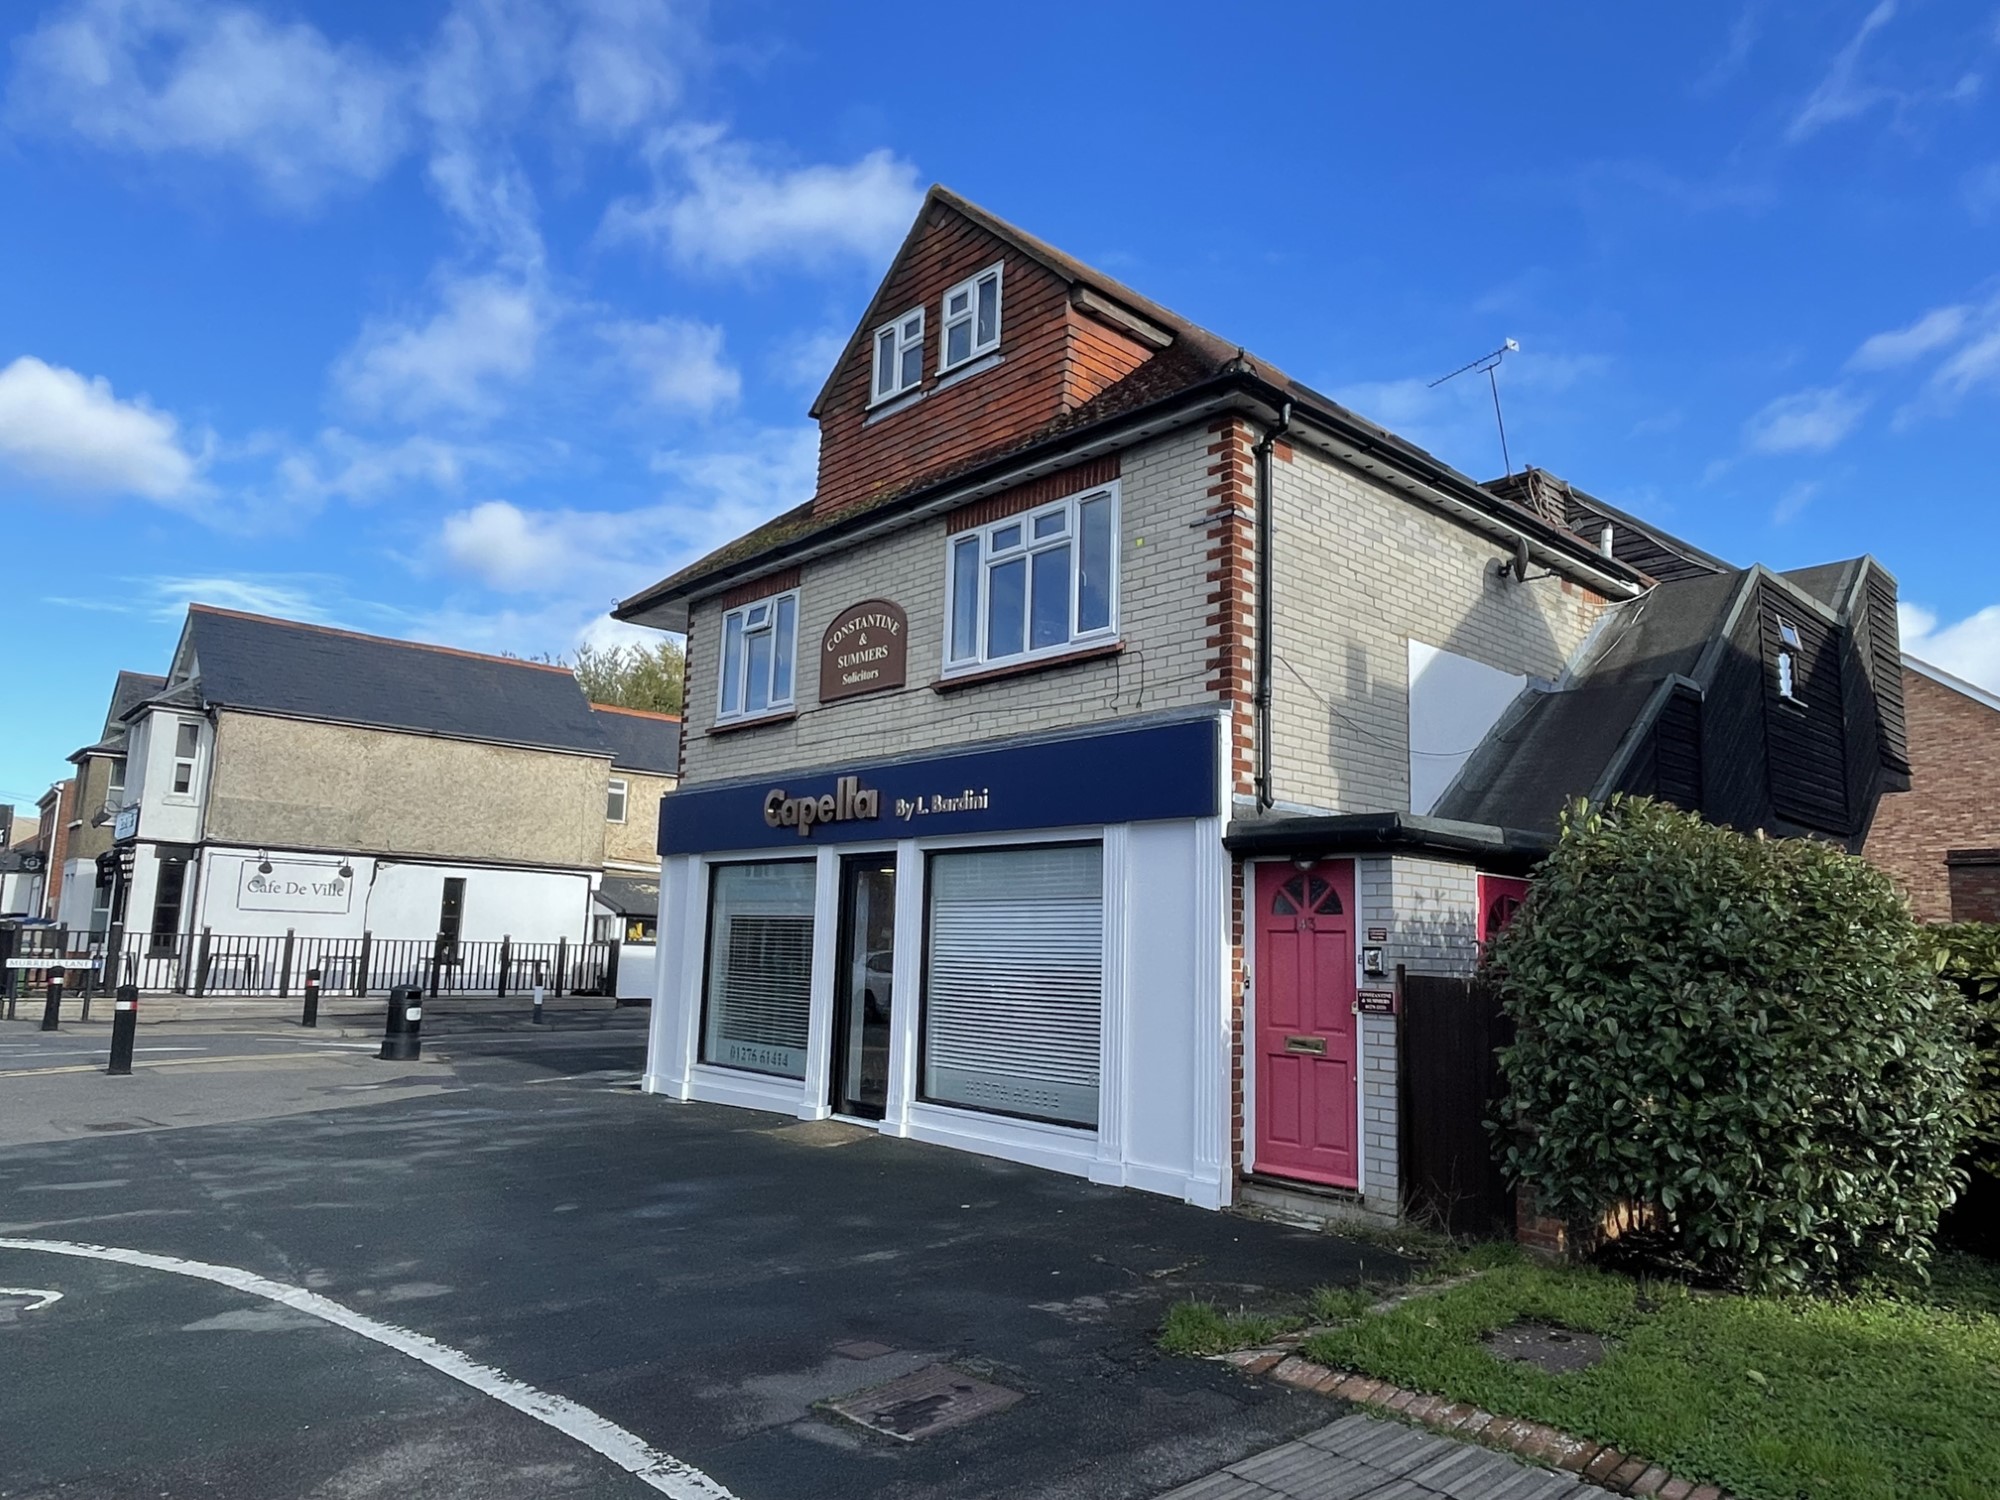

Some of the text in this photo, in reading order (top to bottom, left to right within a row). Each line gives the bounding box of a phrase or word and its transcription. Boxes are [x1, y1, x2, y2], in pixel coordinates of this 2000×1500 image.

[826, 613, 901, 652] CONSTANTINE
[858, 632, 868, 646] &
[837, 645, 889, 669] SUMMERS
[841, 669, 879, 685] Solicitors
[764, 776, 879, 837] Capella
[895, 798, 915, 821] By
[931, 788, 989, 814] Bardini
[247, 879, 344, 897] Cafe De Ville
[65, 959, 89, 968] LANE
[730, 1045, 789, 1067] 01276 61414
